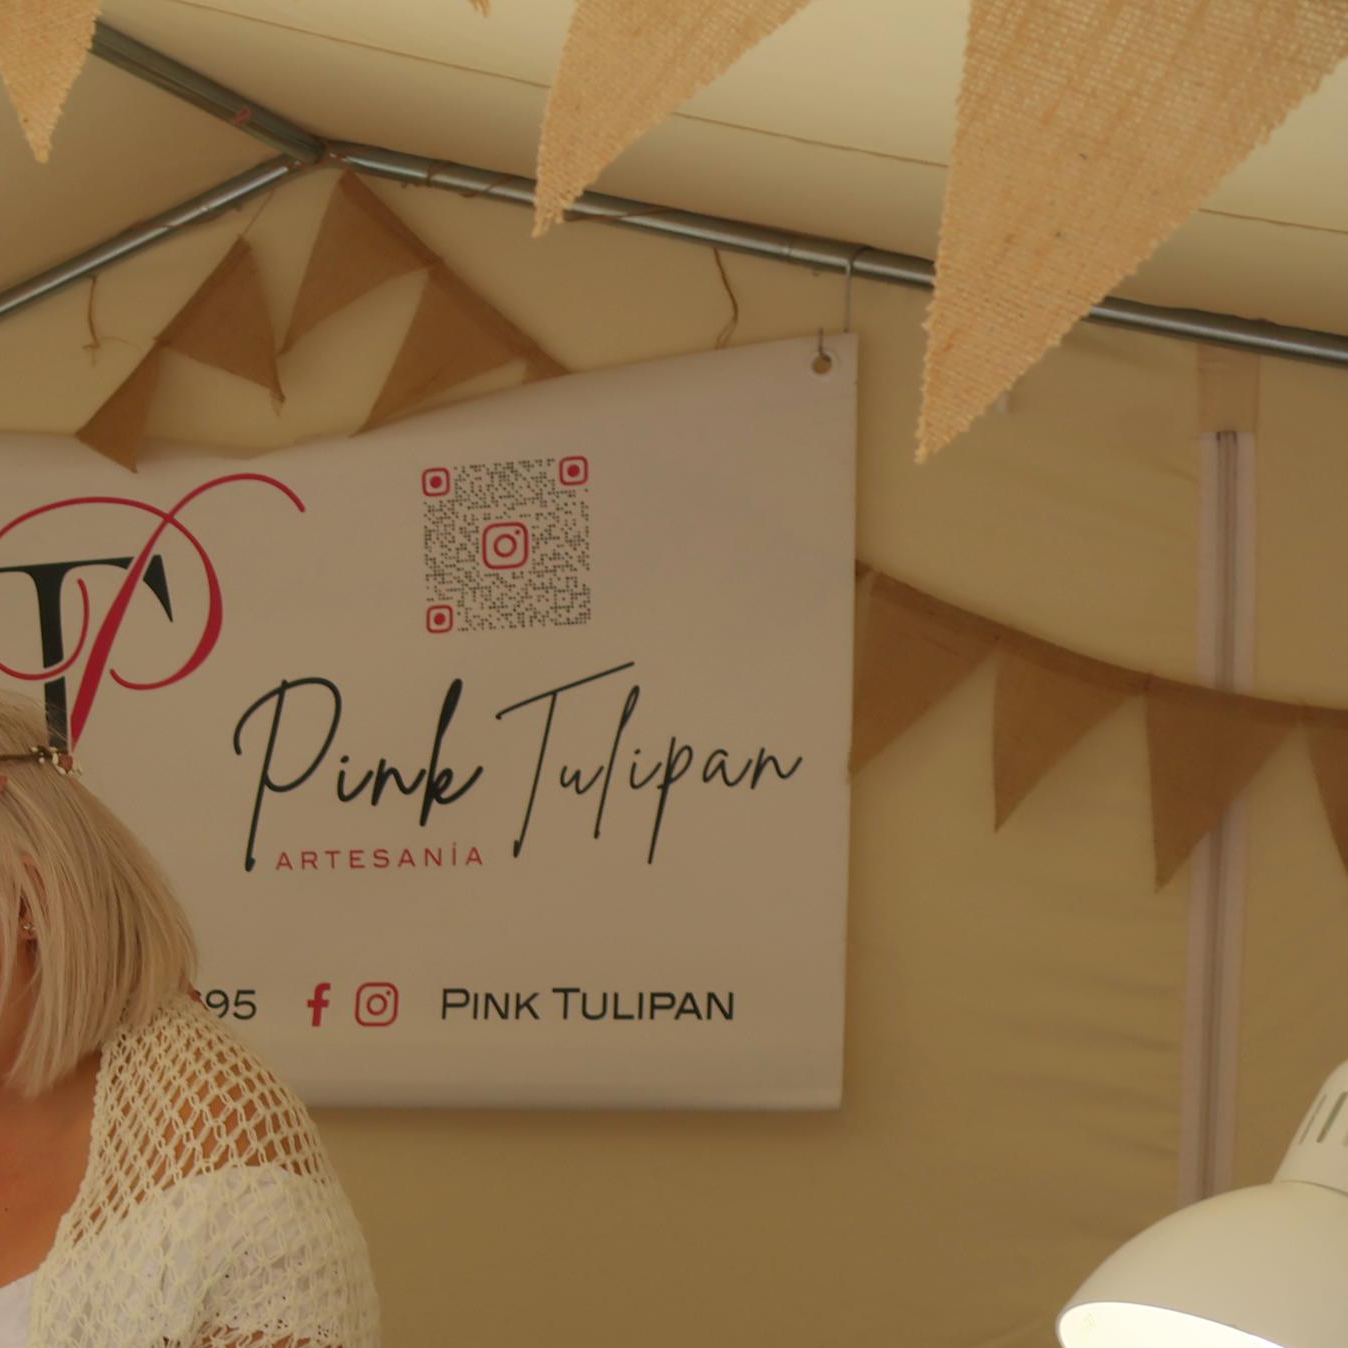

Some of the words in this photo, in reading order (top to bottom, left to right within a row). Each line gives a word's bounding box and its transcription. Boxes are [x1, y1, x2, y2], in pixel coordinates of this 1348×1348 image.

[233, 677, 483, 871] Pink
[495, 661, 803, 865] Tulipan
[275, 841, 483, 870] ARTESANÍA
[195, 988, 257, 1020] 95
[441, 987, 540, 1021] PINK
[551, 987, 735, 1021] TULIPAN
